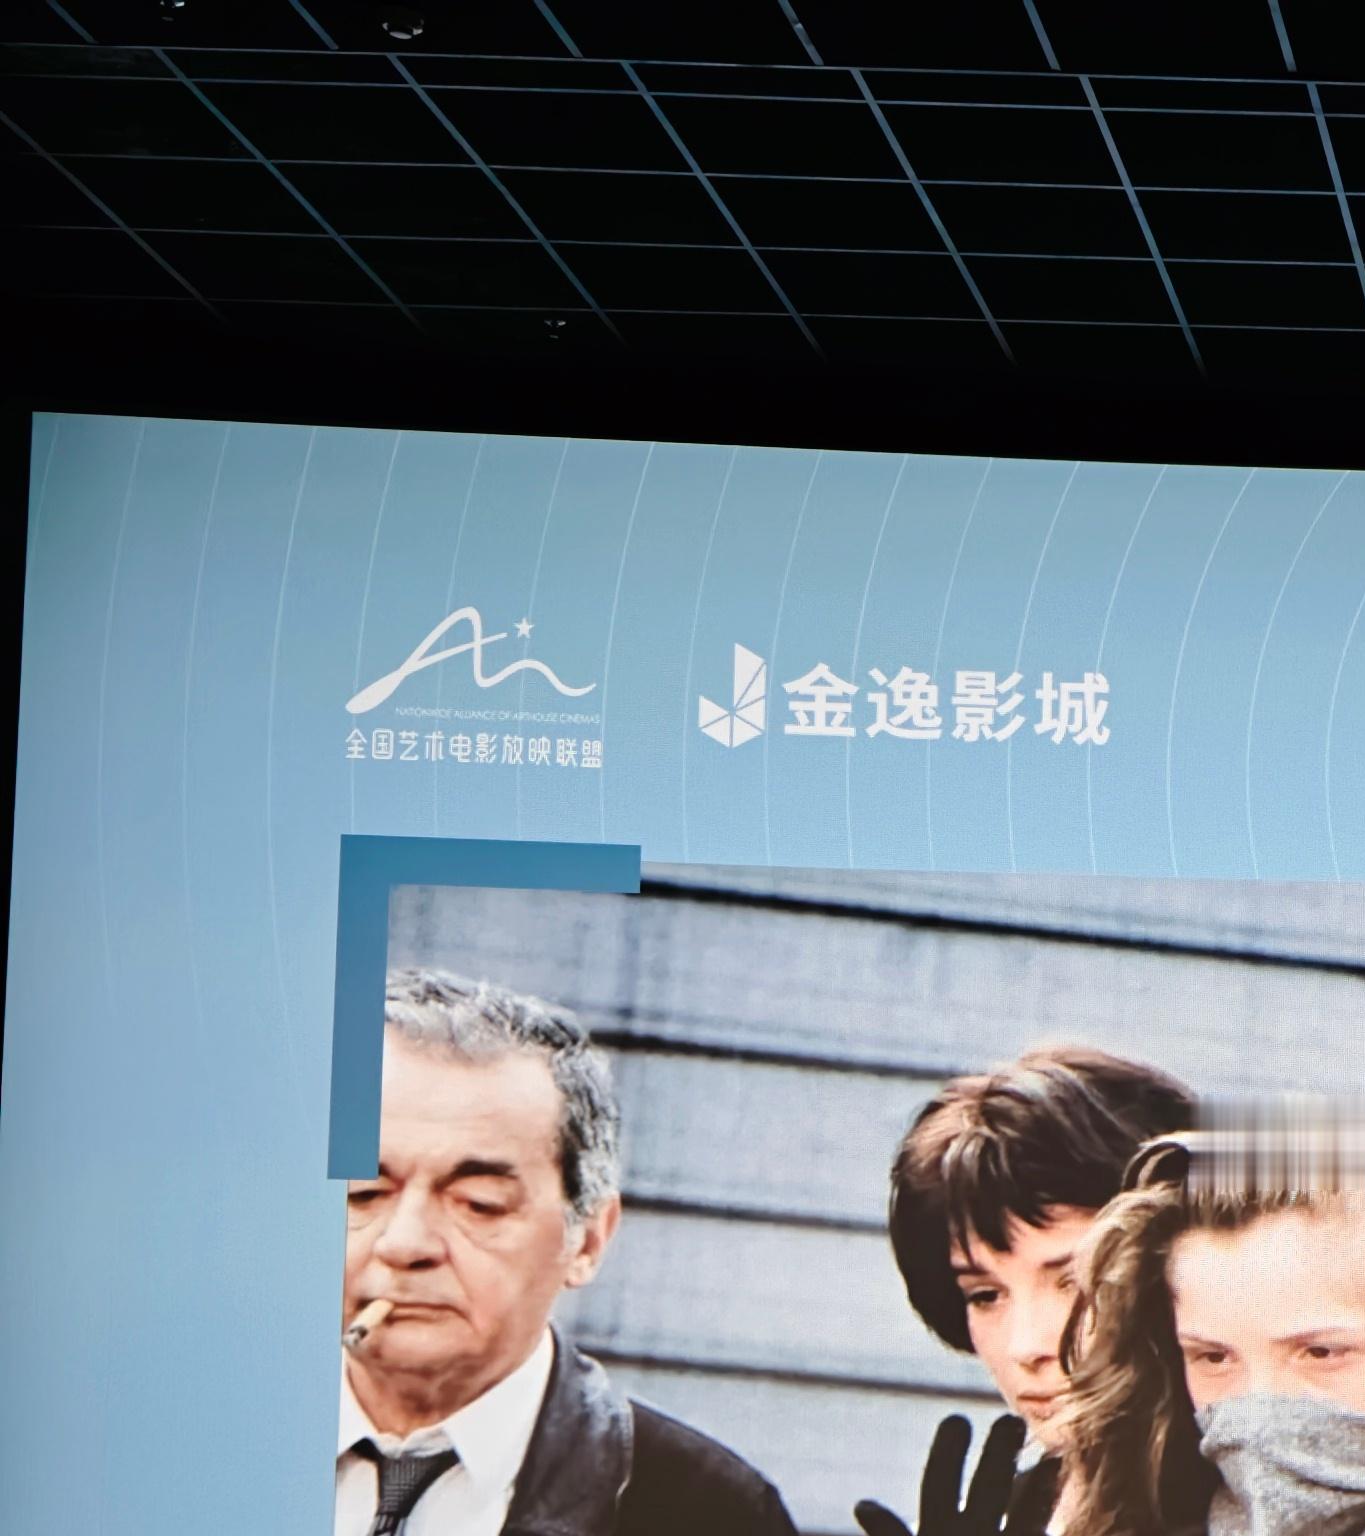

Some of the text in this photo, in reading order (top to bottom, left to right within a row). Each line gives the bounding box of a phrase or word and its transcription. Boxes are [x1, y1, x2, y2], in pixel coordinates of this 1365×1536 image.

[781, 662, 1111, 746] 金逸影城
[345, 728, 602, 768] 全国艺术电影放映联盟
